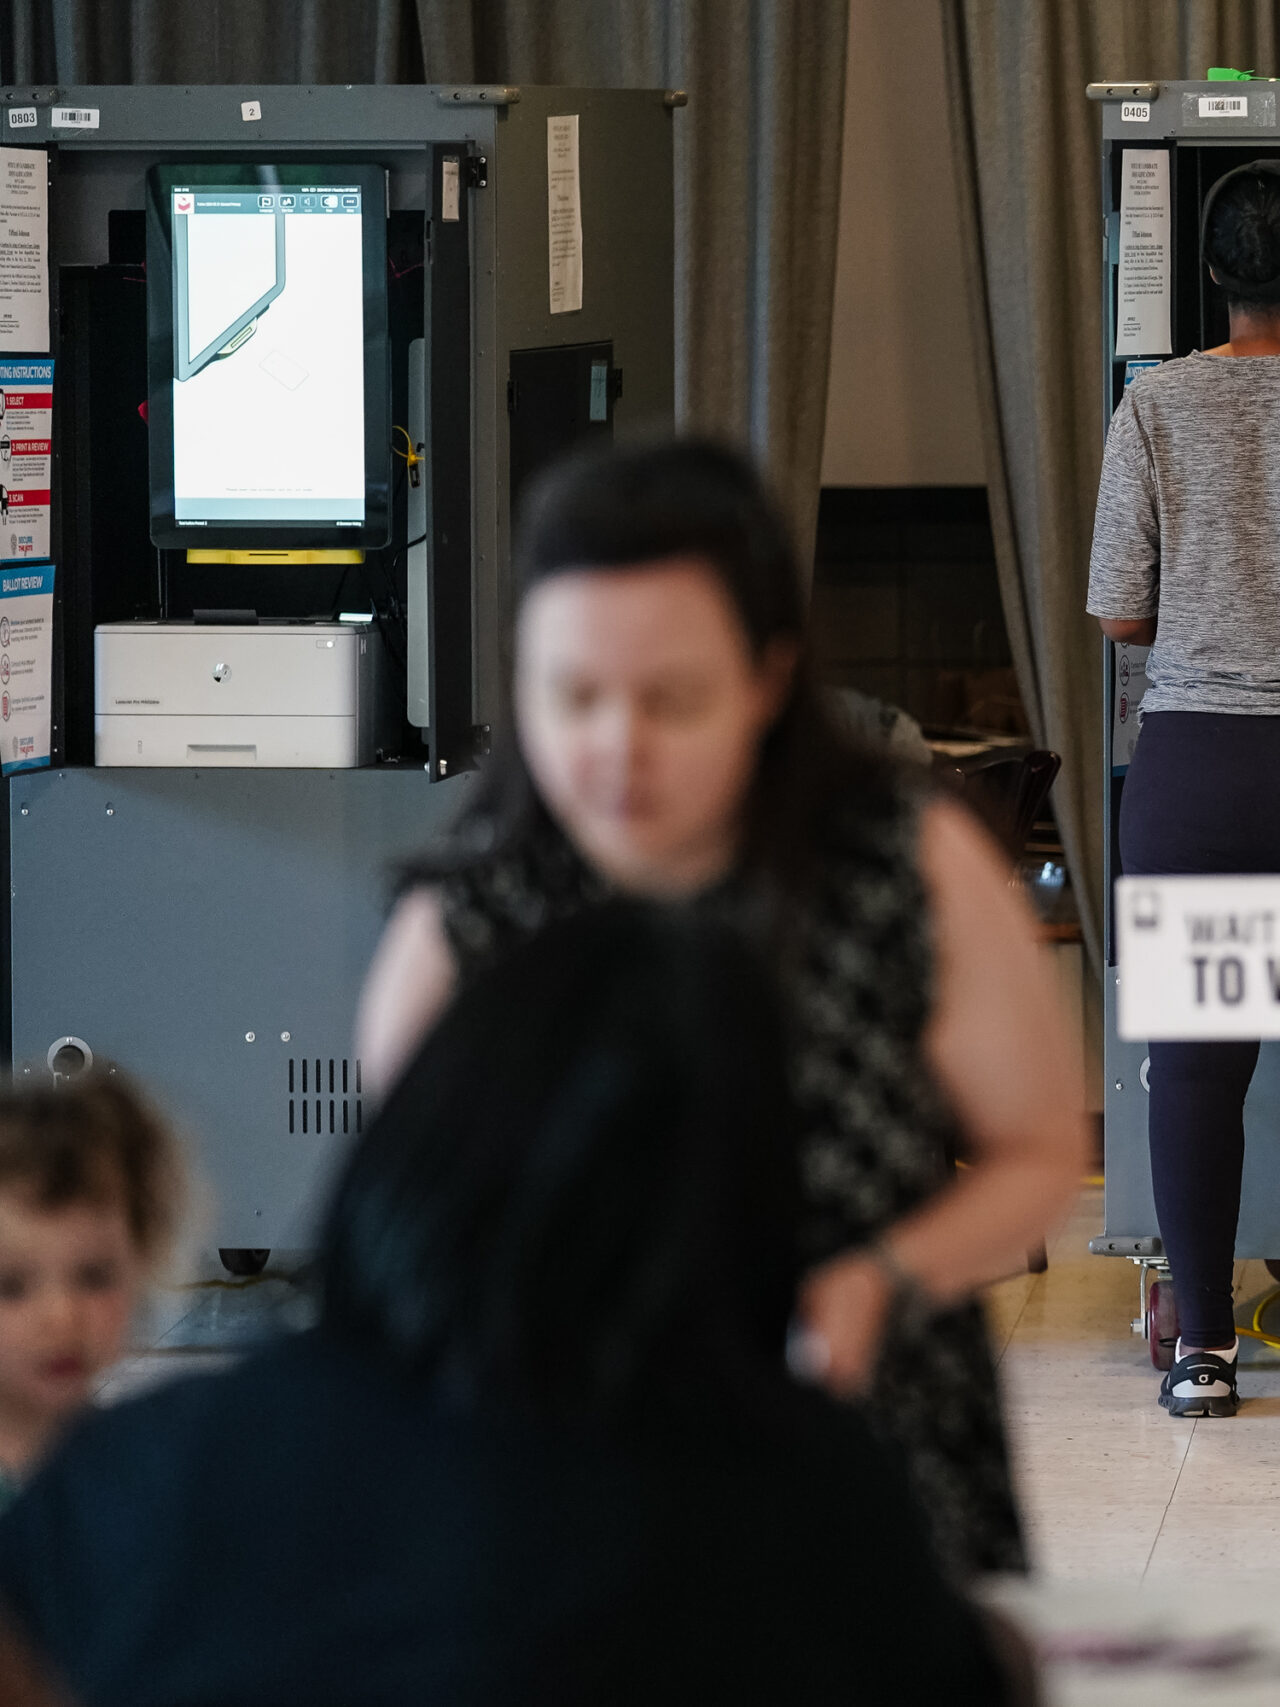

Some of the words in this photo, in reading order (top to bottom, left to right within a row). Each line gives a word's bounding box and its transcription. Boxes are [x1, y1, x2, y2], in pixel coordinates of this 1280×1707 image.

[11, 112, 36, 125] 0803
[249, 108, 255, 116] 2
[1123, 106, 1148, 118] 0405
[13, 366, 52, 379] INSTRUCTIONS
[2, 577, 21, 592] BALLOT
[21, 576, 43, 589] REVIEW
[1186, 909, 1275, 944] WAIT
[1191, 955, 1246, 1006] TO
